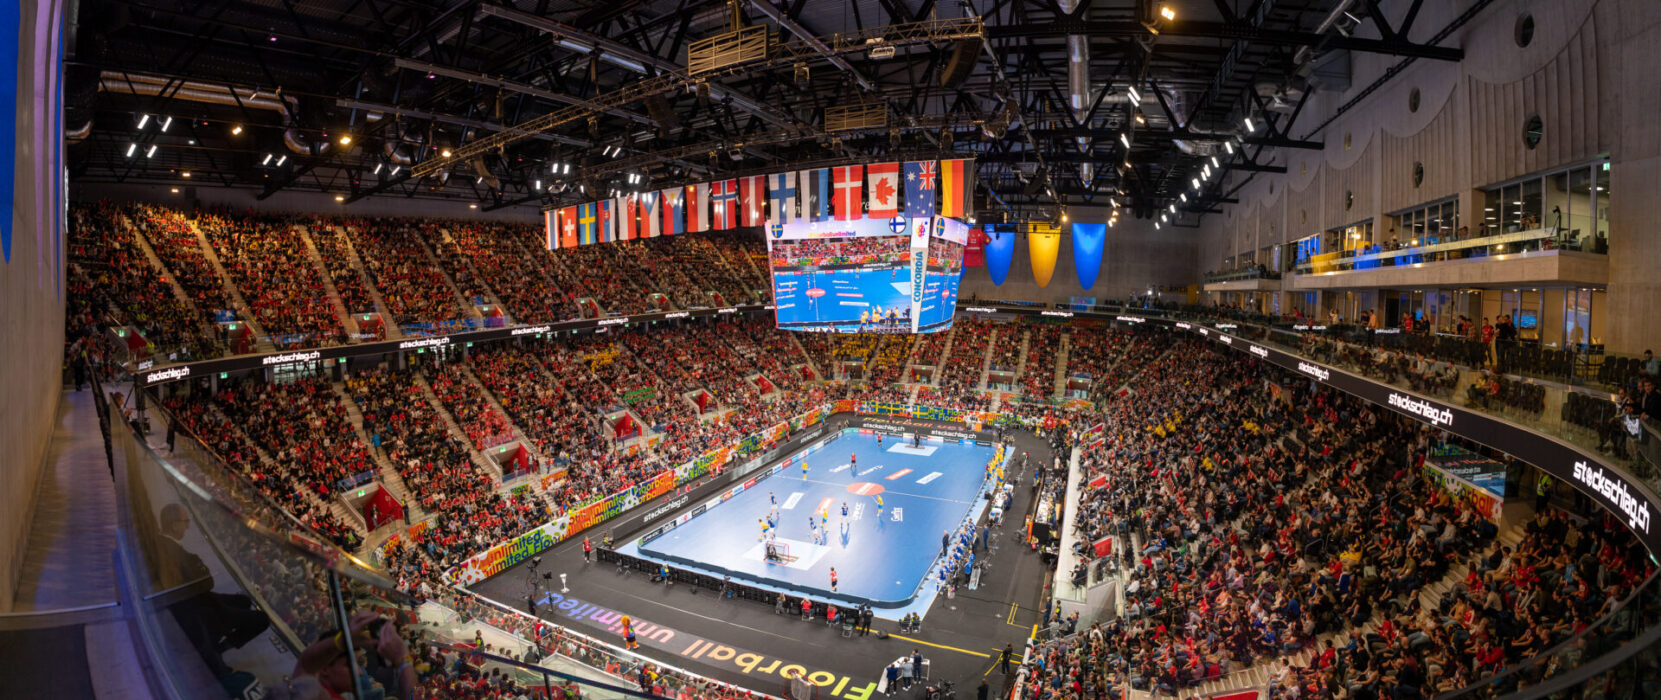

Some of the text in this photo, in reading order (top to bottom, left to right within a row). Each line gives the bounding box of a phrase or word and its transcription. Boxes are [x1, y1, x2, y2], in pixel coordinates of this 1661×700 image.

[913, 251, 923, 303] CONCORDIA
[400, 336, 450, 348] stockschlag.ch
[262, 350, 320, 365] stockschlag.ch
[147, 366, 190, 383] stockschlag.ch
[1388, 392, 1453, 426] stockschlag.ch
[931, 430, 976, 440] stockschlag.ch
[643, 494, 689, 522] stockschlag.ch
[1573, 461, 1651, 535] stockschlag.ch
[681, 640, 877, 700] Floorball
